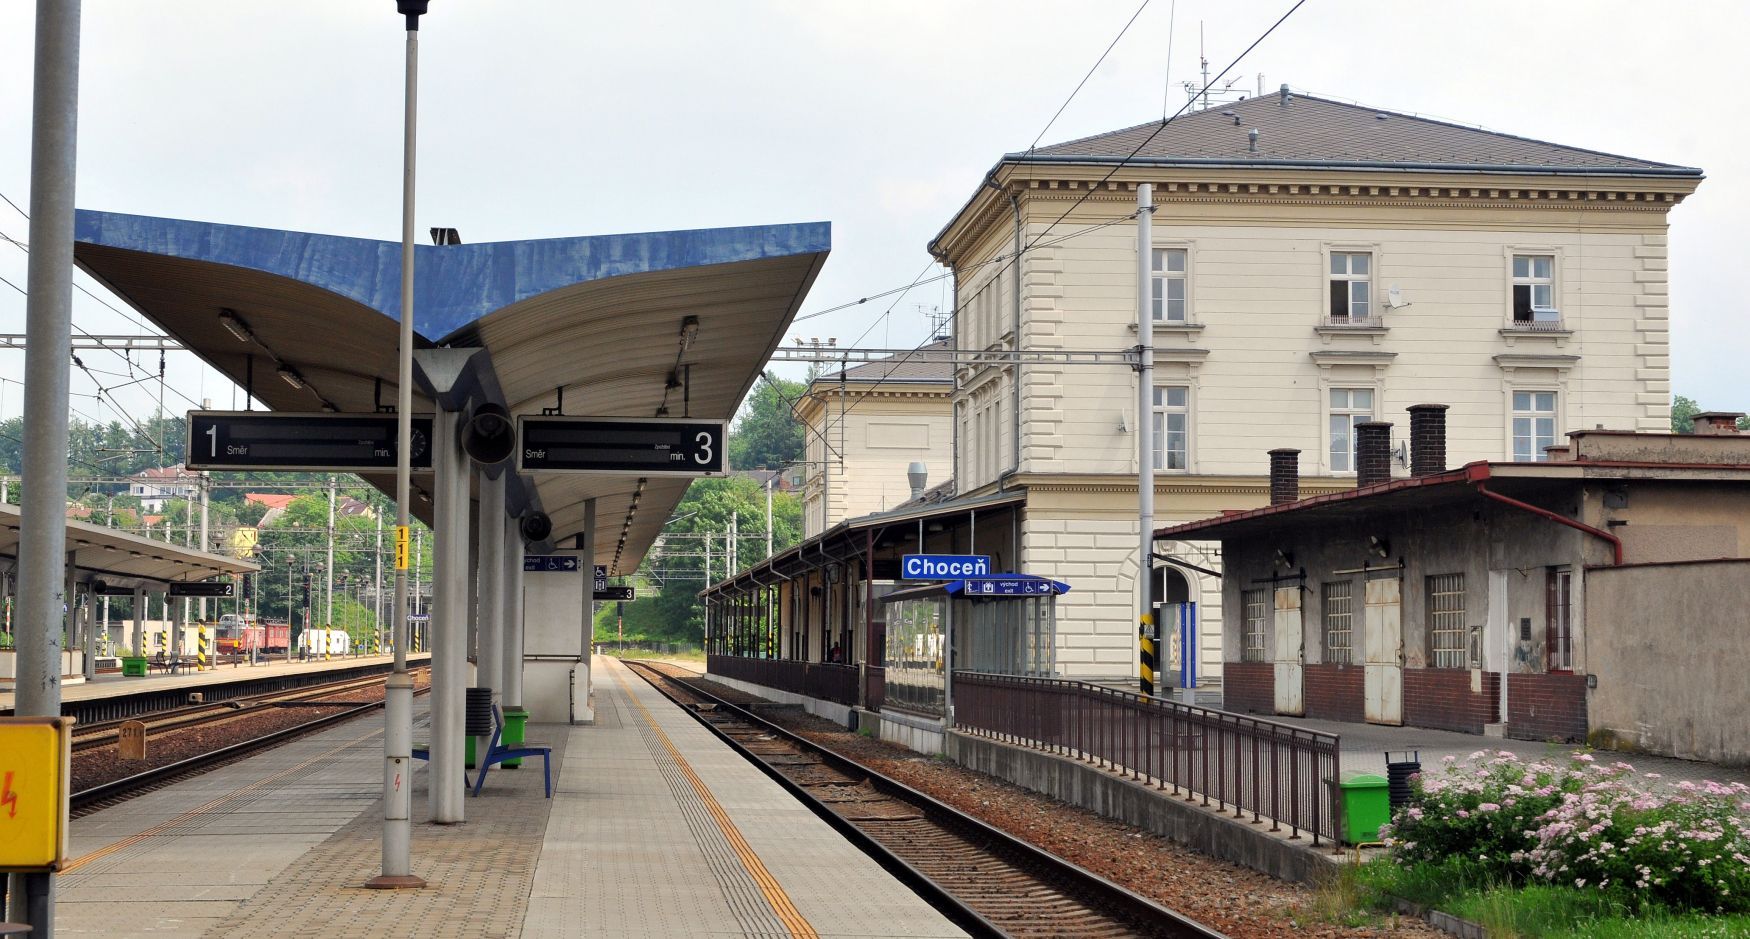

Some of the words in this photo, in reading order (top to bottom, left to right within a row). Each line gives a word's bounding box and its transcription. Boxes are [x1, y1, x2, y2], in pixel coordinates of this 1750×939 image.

[206, 424, 216, 457] 1
[227, 445, 248, 455] Směr
[374, 448, 390, 456] min.
[694, 432, 713, 464] 3
[526, 449, 546, 458] Směr
[670, 451, 686, 460] min.
[907, 558, 986, 575] Choceň
[226, 585, 232, 594] 2
[626, 589, 632, 598] 3
